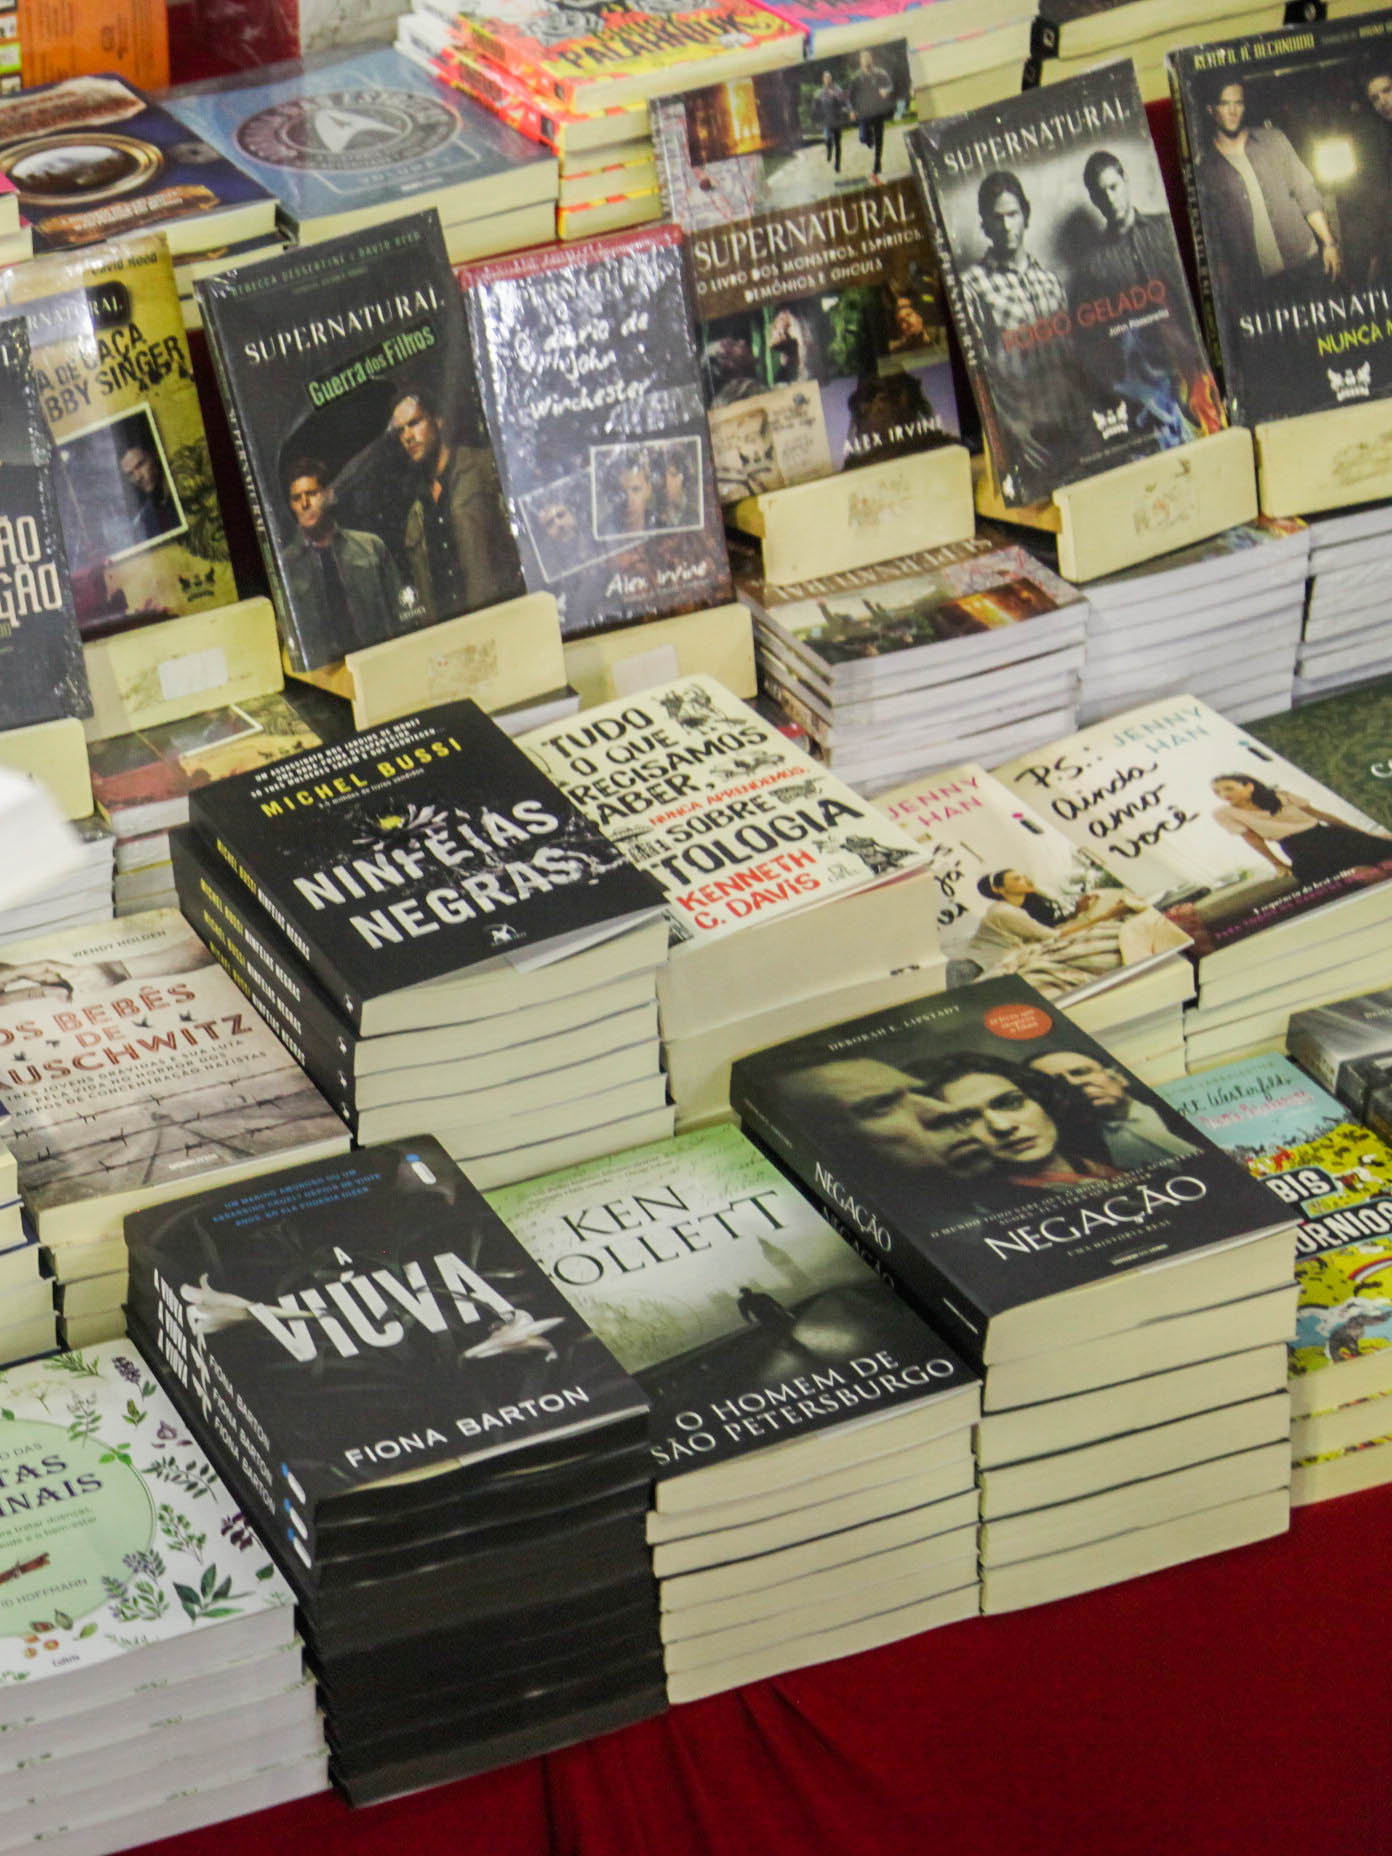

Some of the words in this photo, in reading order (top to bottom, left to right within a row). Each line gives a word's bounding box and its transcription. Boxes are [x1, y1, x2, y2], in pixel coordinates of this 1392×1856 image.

[943, 97, 1130, 173] SUPERNATURAL
[693, 192, 916, 273] SUPERNATURAL
[711, 270, 748, 292] LIVRO
[751, 262, 780, 281] DOS
[244, 285, 445, 365] SUPERNATURAL
[1002, 312, 1072, 351] FOGO
[1076, 280, 1168, 327] GELADO
[1317, 321, 1384, 357] NUNCA
[44, 382, 93, 424] BBY
[96, 334, 187, 397] SINGER
[308, 360, 367, 407] Guerra
[364, 350, 388, 378] dos
[383, 325, 437, 368] Filhos
[842, 429, 884, 454] ALEX
[541, 706, 656, 760] TUDO
[569, 756, 600, 778] O
[605, 728, 681, 766] QUE
[1113, 705, 1204, 748] JENNY
[1145, 725, 1210, 756] HAN
[260, 773, 369, 818] MICHEL
[376, 737, 463, 778] BUSSI
[565, 724, 770, 807] RECISAMOS
[596, 773, 716, 826] ABER,
[666, 792, 777, 845] SOBRE
[888, 774, 982, 822] JENNY
[916, 795, 984, 828] HAN
[1087, 783, 1166, 840] amo
[292, 800, 559, 911] NINFEIAS
[644, 798, 865, 887] TOLOGIA
[1109, 803, 1201, 859] você
[349, 847, 584, 949] NEGRAS
[675, 848, 818, 913] KENNETH
[72, 942, 114, 959] WENDY
[116, 929, 167, 948] HOLDEN
[693, 905, 727, 931] C.
[51, 981, 198, 1034] BEBÊS
[74, 1023, 124, 1050] DE
[14, 1101, 65, 1119] AMPOS
[66, 1094, 86, 1106] DE
[203, 1050, 268, 1073] NAZISTAS
[44, 1075, 96, 1095] JOVENS
[181, 1046, 208, 1061] SUA
[210, 1038, 244, 1054] LUTA
[72, 1081, 107, 1098] VIDA
[134, 1058, 196, 1082] HORROR
[560, 1184, 692, 1243] KEN
[814, 1160, 893, 1253] NEGAÇÃO
[1264, 1167, 1335, 1204] BIS
[540, 1188, 790, 1288] OLLETT
[983, 1175, 1208, 1261] NEGAÇÃO
[332, 1246, 353, 1266] A
[248, 1251, 515, 1363] VIÚVA
[209, 1351, 235, 1399] FIONA
[235, 1392, 271, 1452] BARTON
[649, 1430, 716, 1468] SÃO
[722, 1357, 956, 1442] PETERSBURGO
[675, 1410, 704, 1434] O
[710, 1367, 845, 1422] HOMEM
[848, 1349, 901, 1378] DE
[12, 1441, 44, 1456] DAS
[212, 1385, 239, 1433] FIONA
[239, 1425, 274, 1488] BARTON
[343, 1427, 449, 1470] FIONA
[455, 1384, 591, 1439] BARTON
[214, 1414, 240, 1462] FIONA
[241, 1455, 277, 1516] BARTON
[14, 1519, 44, 1534] tratar
[16, 1577, 89, 1605] HOFFMANN
